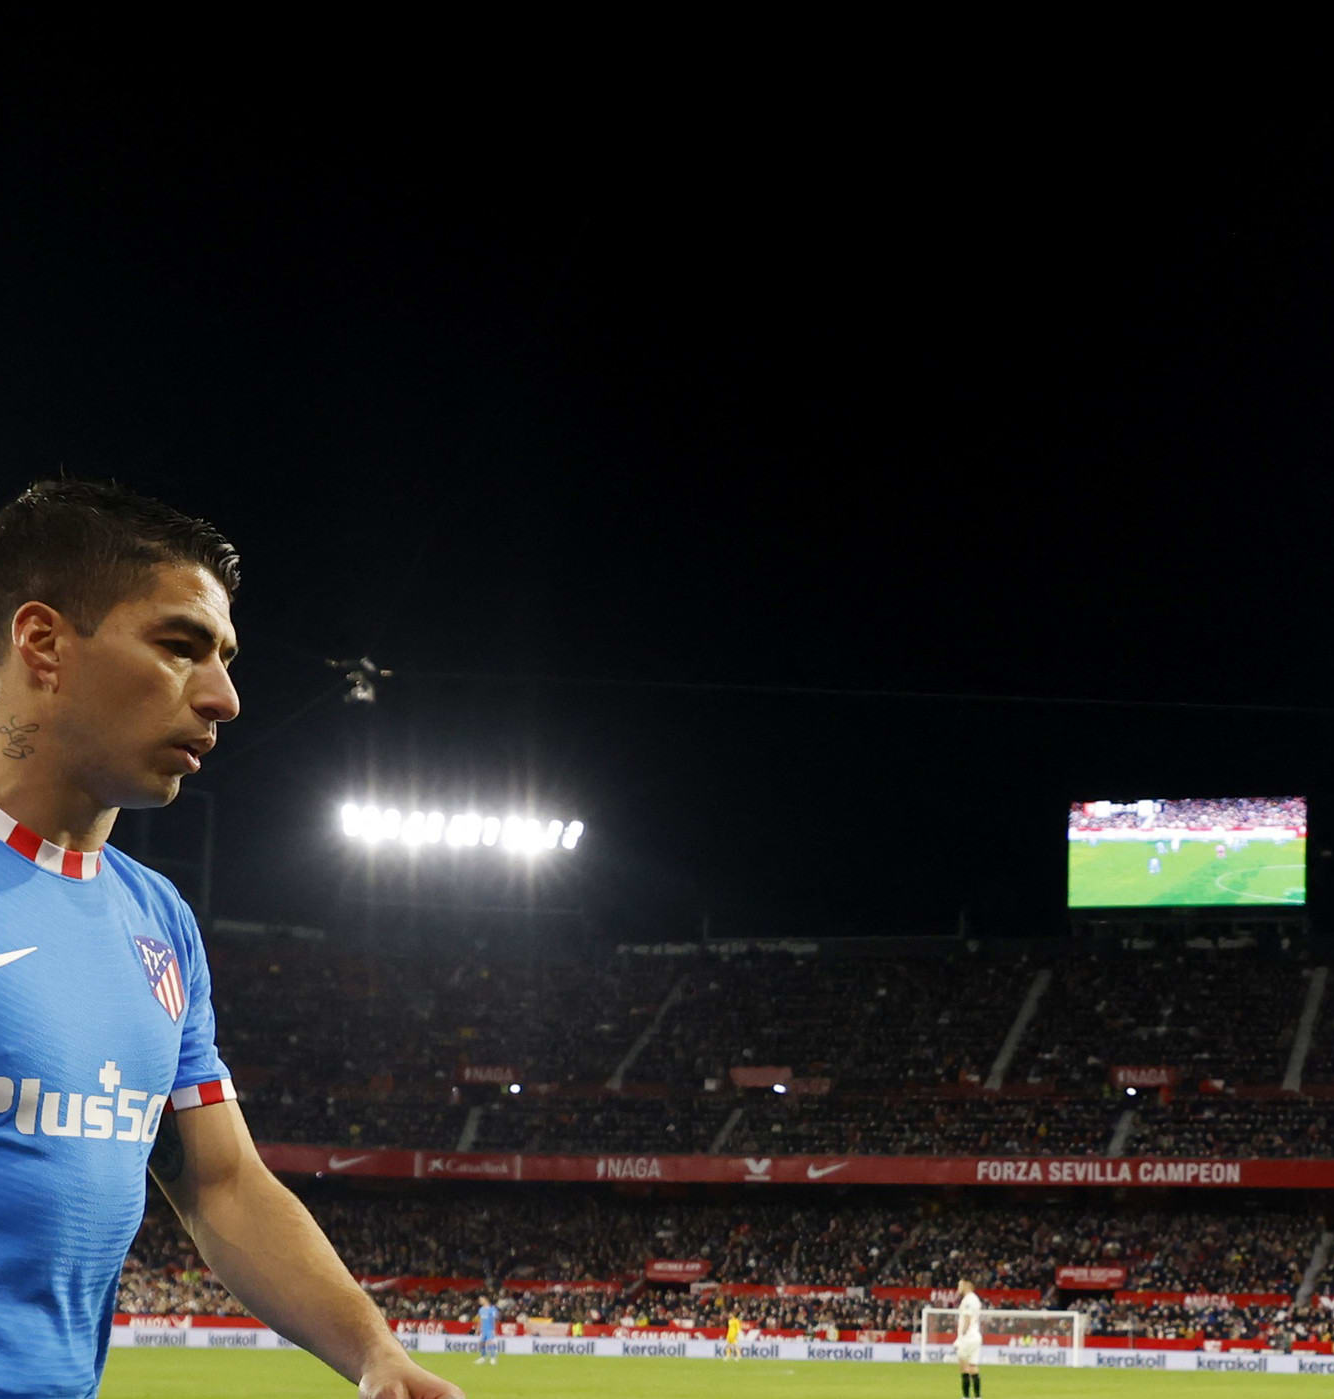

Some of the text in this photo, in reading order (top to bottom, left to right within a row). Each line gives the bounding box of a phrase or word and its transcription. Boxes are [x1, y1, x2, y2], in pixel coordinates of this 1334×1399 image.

[607, 1158, 661, 1178] NAGA
[977, 1161, 1240, 1183] FORZA SEVILLA CAMPEON
[445, 1339, 506, 1353] kerall
[532, 1341, 595, 1355] kerakoll
[622, 1342, 685, 1357] kerakoll
[808, 1346, 873, 1360] kerakoll
[1097, 1352, 1166, 1368] kerakoll
[1197, 1355, 1267, 1372] kerakoll
